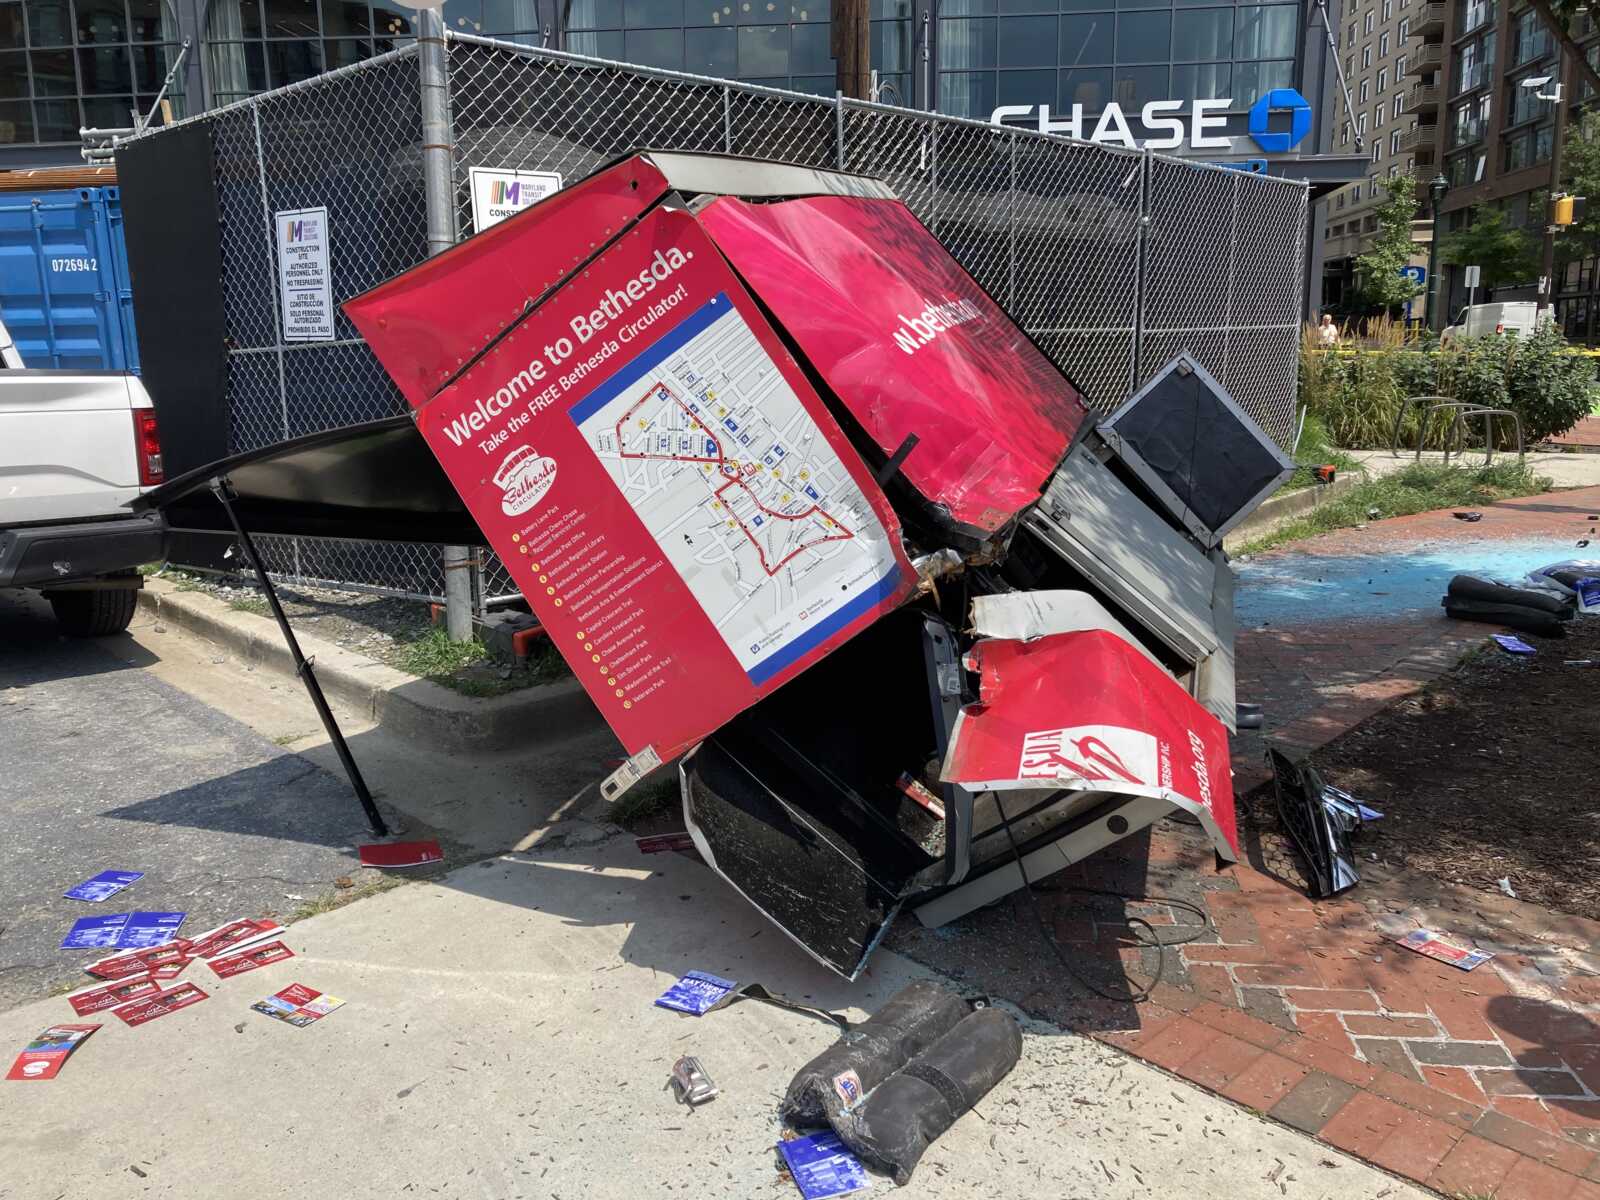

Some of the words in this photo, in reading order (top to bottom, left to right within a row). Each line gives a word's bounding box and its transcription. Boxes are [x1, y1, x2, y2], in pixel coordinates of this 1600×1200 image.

[990, 98, 1234, 150] CHASE
[286, 245, 319, 254] CONSTRUCTION
[286, 269, 311, 278] PERSONNEL
[290, 262, 318, 270] AUTHORIZED
[443, 358, 547, 447] Welcome
[543, 337, 573, 366] to
[569, 247, 694, 344] Bethesda.
[478, 427, 504, 456] Take
[503, 412, 526, 433] the
[528, 386, 560, 416] FREE
[561, 341, 620, 391] Bethesda
[618, 283, 689, 343] Circulator!
[504, 458, 557, 504] Bethesda
[512, 479, 552, 511] CIRCULATOR
[547, 505, 558, 515] Park
